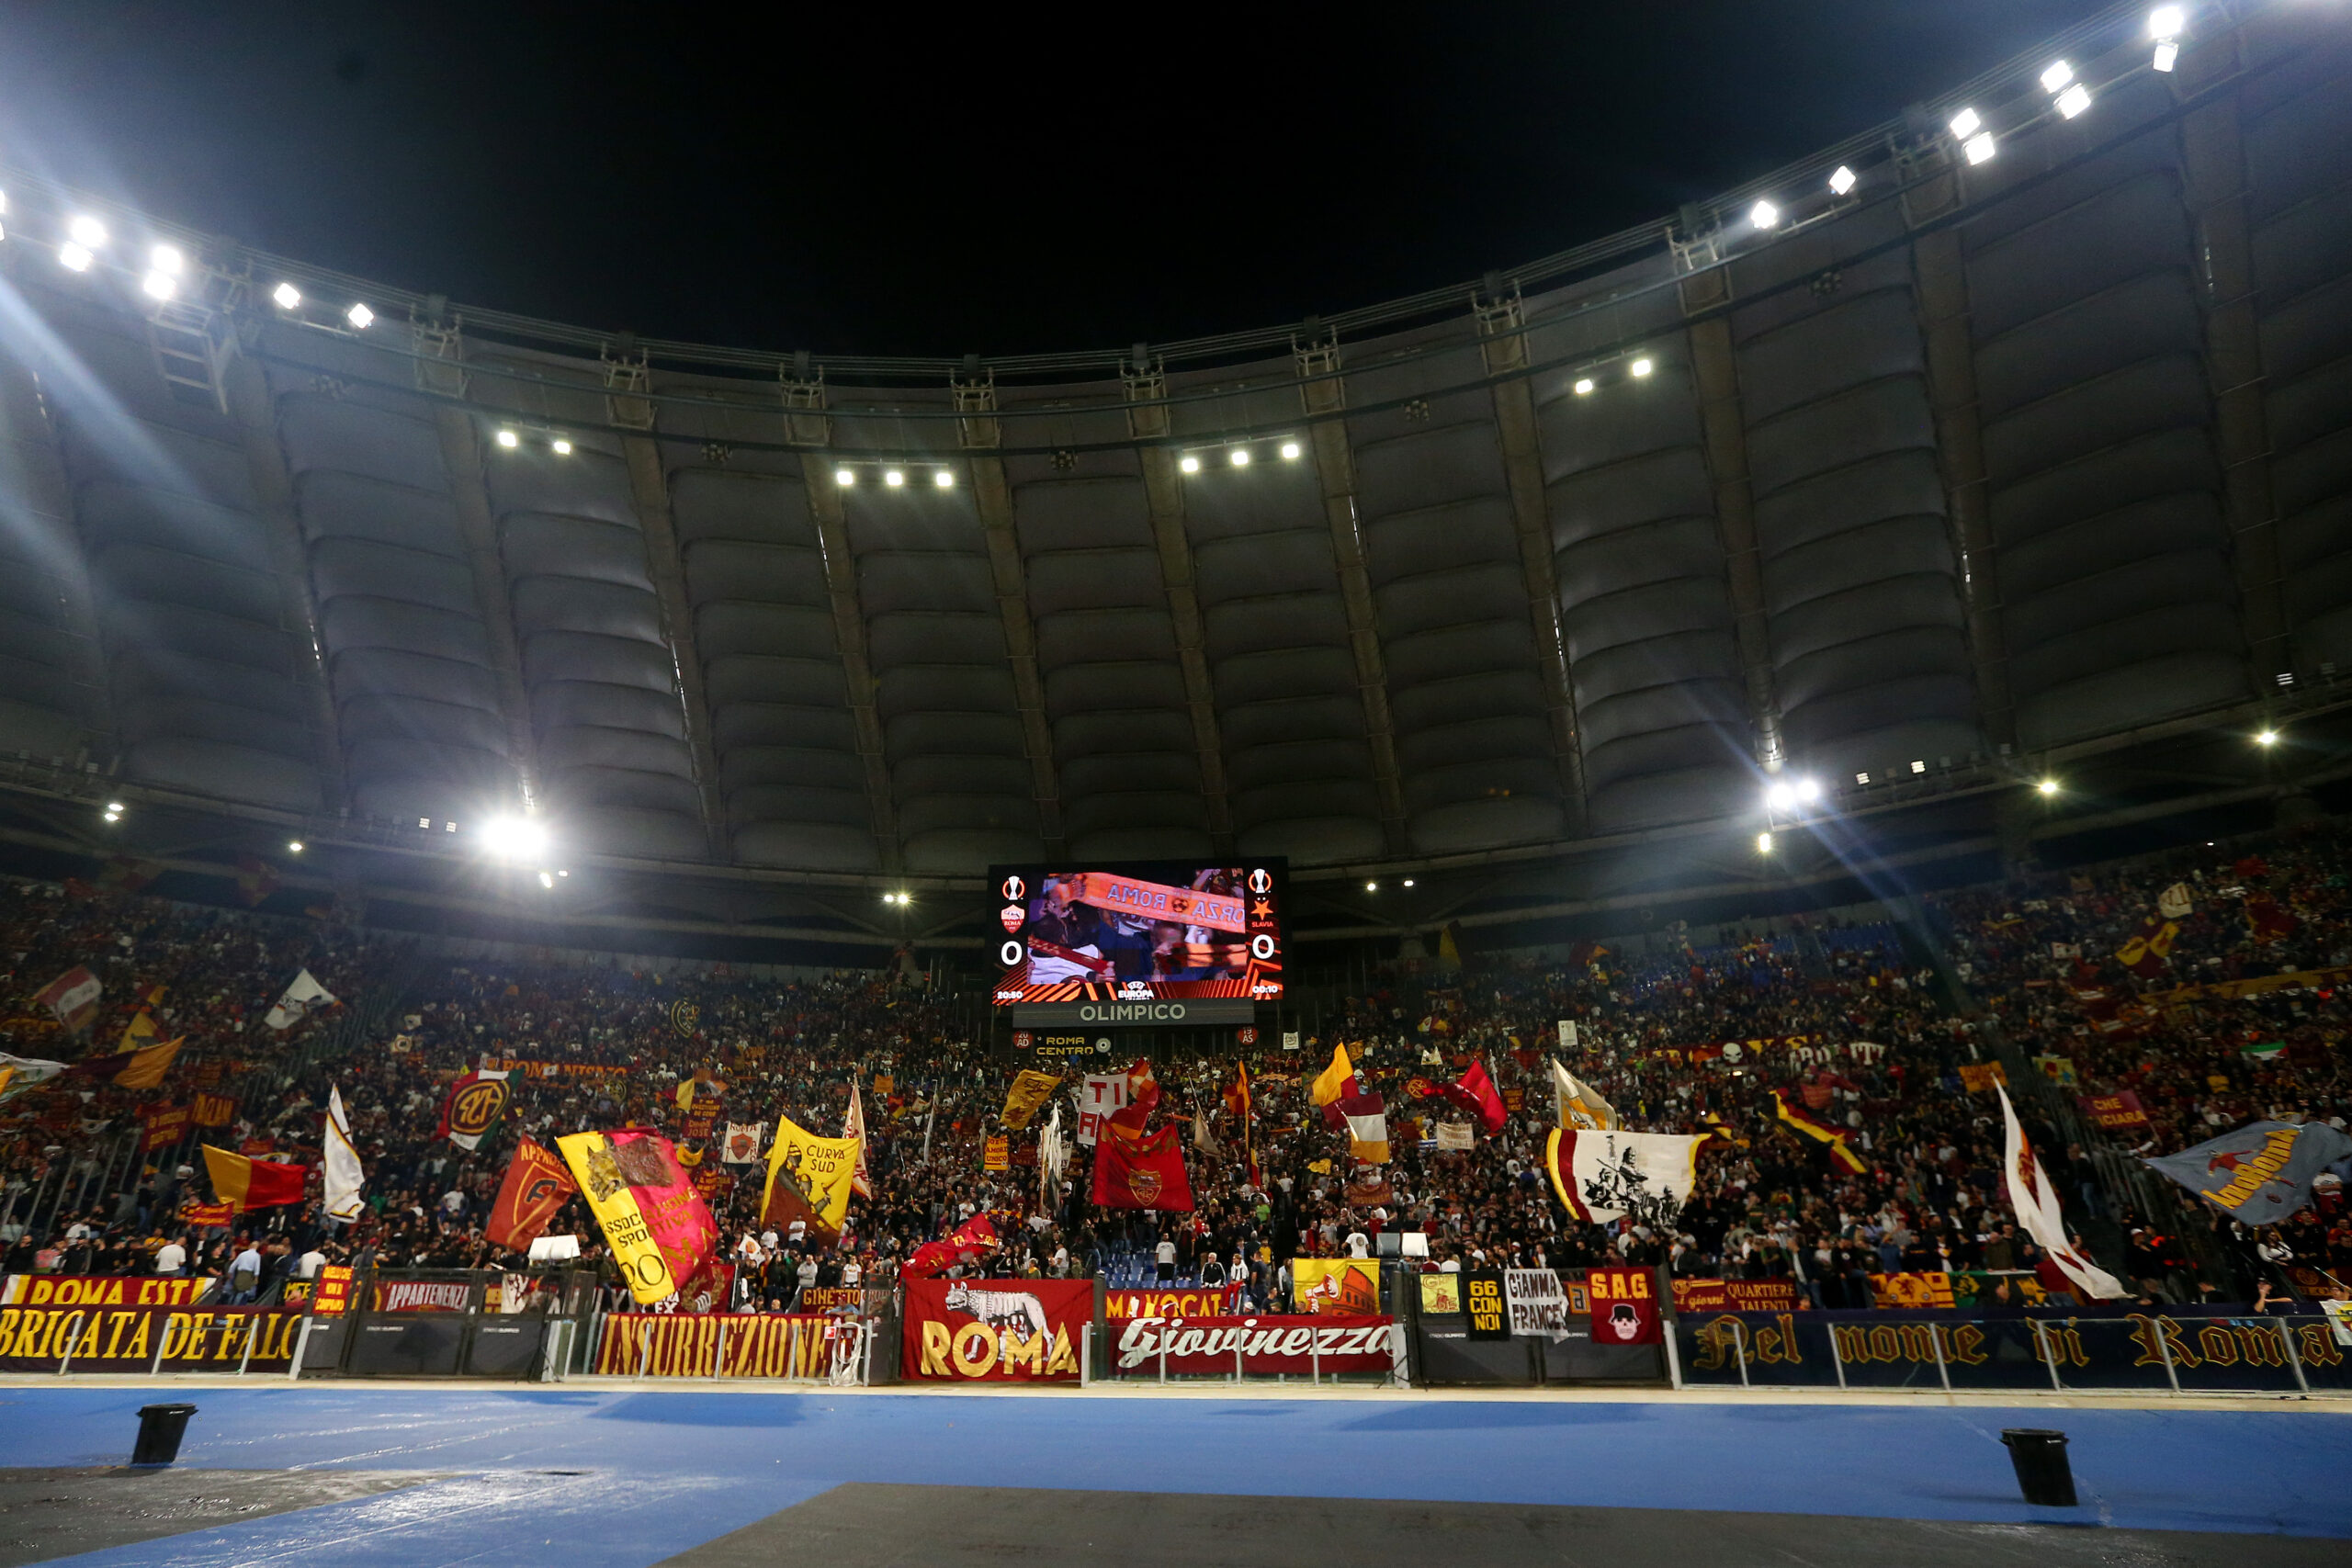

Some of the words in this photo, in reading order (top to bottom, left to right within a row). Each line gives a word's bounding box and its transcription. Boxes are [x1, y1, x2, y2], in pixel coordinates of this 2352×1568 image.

[1001, 941, 1023, 965] 0
[1252, 934, 1274, 959] 0
[1118, 989, 1154, 998] EUROPA
[1080, 1004, 1186, 1022] OLIMPICO
[1046, 1036, 1085, 1045] ROMA
[1036, 1046, 1094, 1055] CENTRO
[806, 1144, 846, 1161] CURVA
[810, 1159, 836, 1174] SUD
[1470, 1280, 1498, 1297] 66
[1590, 1272, 1652, 1300] S.A.G.
[1727, 1283, 1794, 1299] QUARTIERE
[1469, 1297, 1502, 1314] CON
[1737, 1300, 1791, 1311] TALENTI
[1473, 1314, 1501, 1331] NOI
[0, 1308, 152, 1359] BRIGATA
[162, 1312, 214, 1359] DE
[1835, 1324, 1989, 1366] nome
[2125, 1313, 2344, 1368] Roma
[920, 1319, 1080, 1378] ROMA
[1117, 1316, 1395, 1369] Giovinezza
